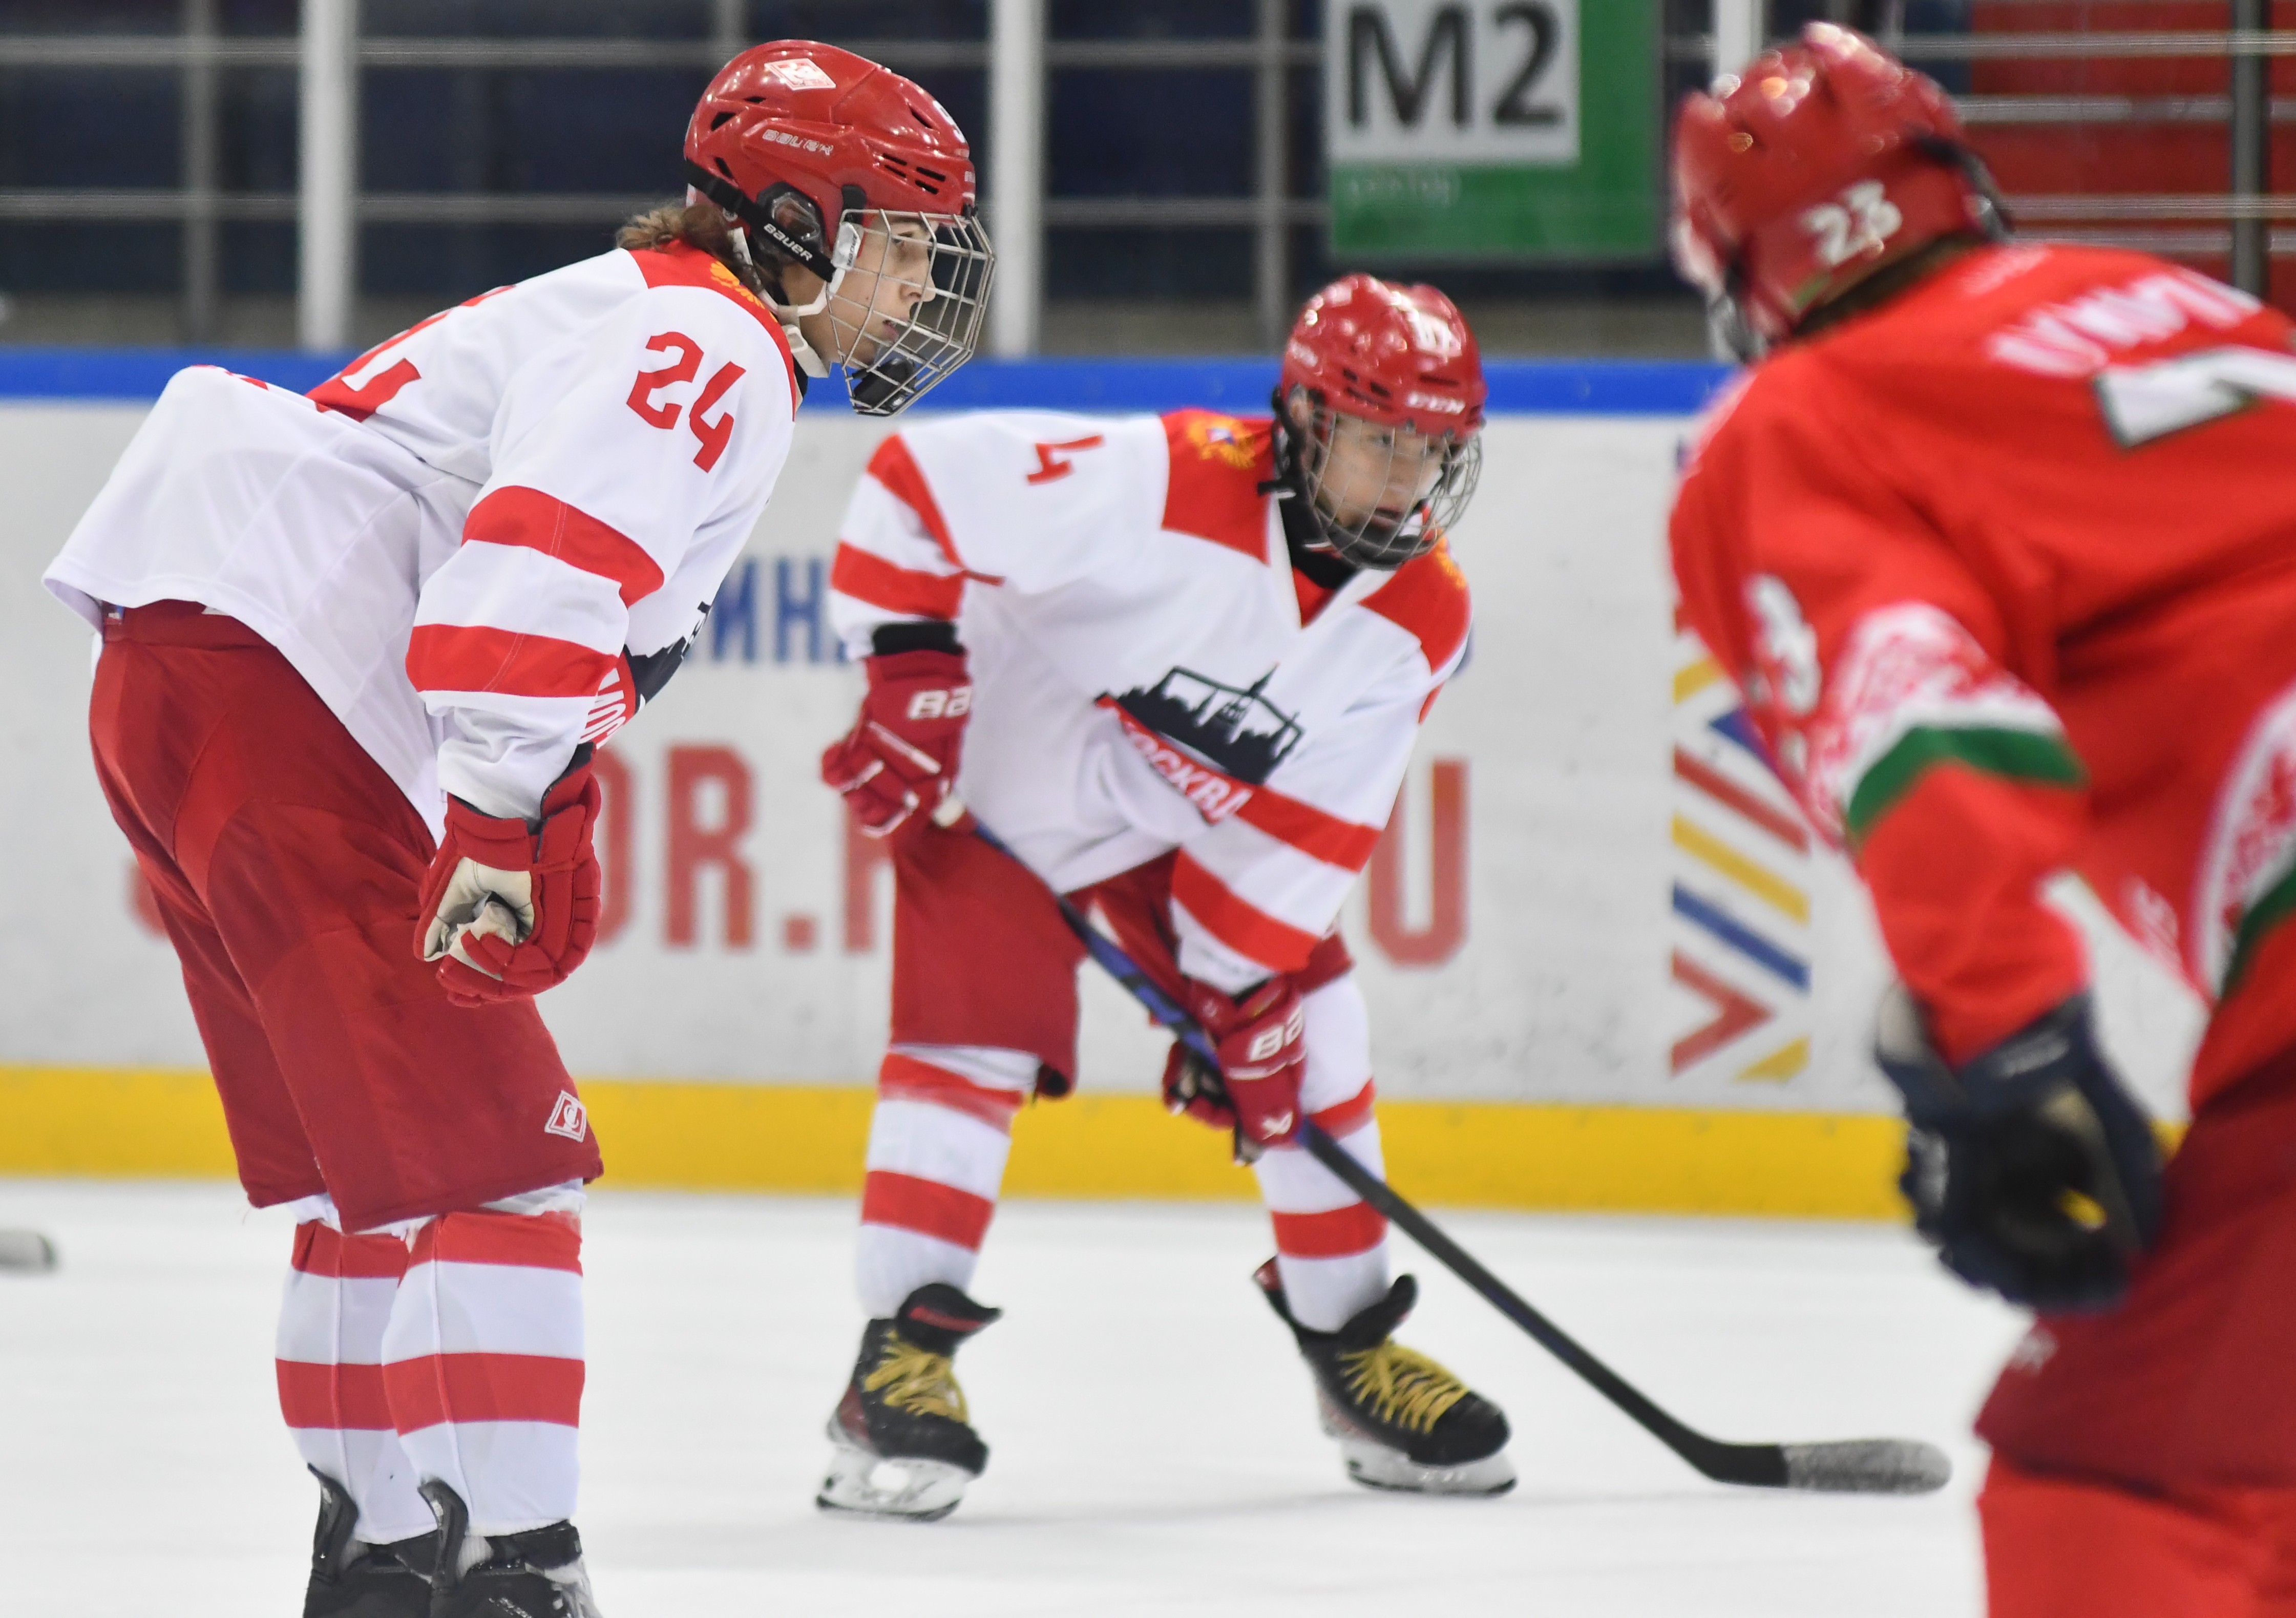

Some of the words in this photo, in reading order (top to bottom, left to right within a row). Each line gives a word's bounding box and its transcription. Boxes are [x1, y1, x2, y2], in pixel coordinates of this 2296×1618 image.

[1347, 4, 1563, 128] M2
[626, 332, 746, 473] 24
[685, 555, 849, 664] ИН
